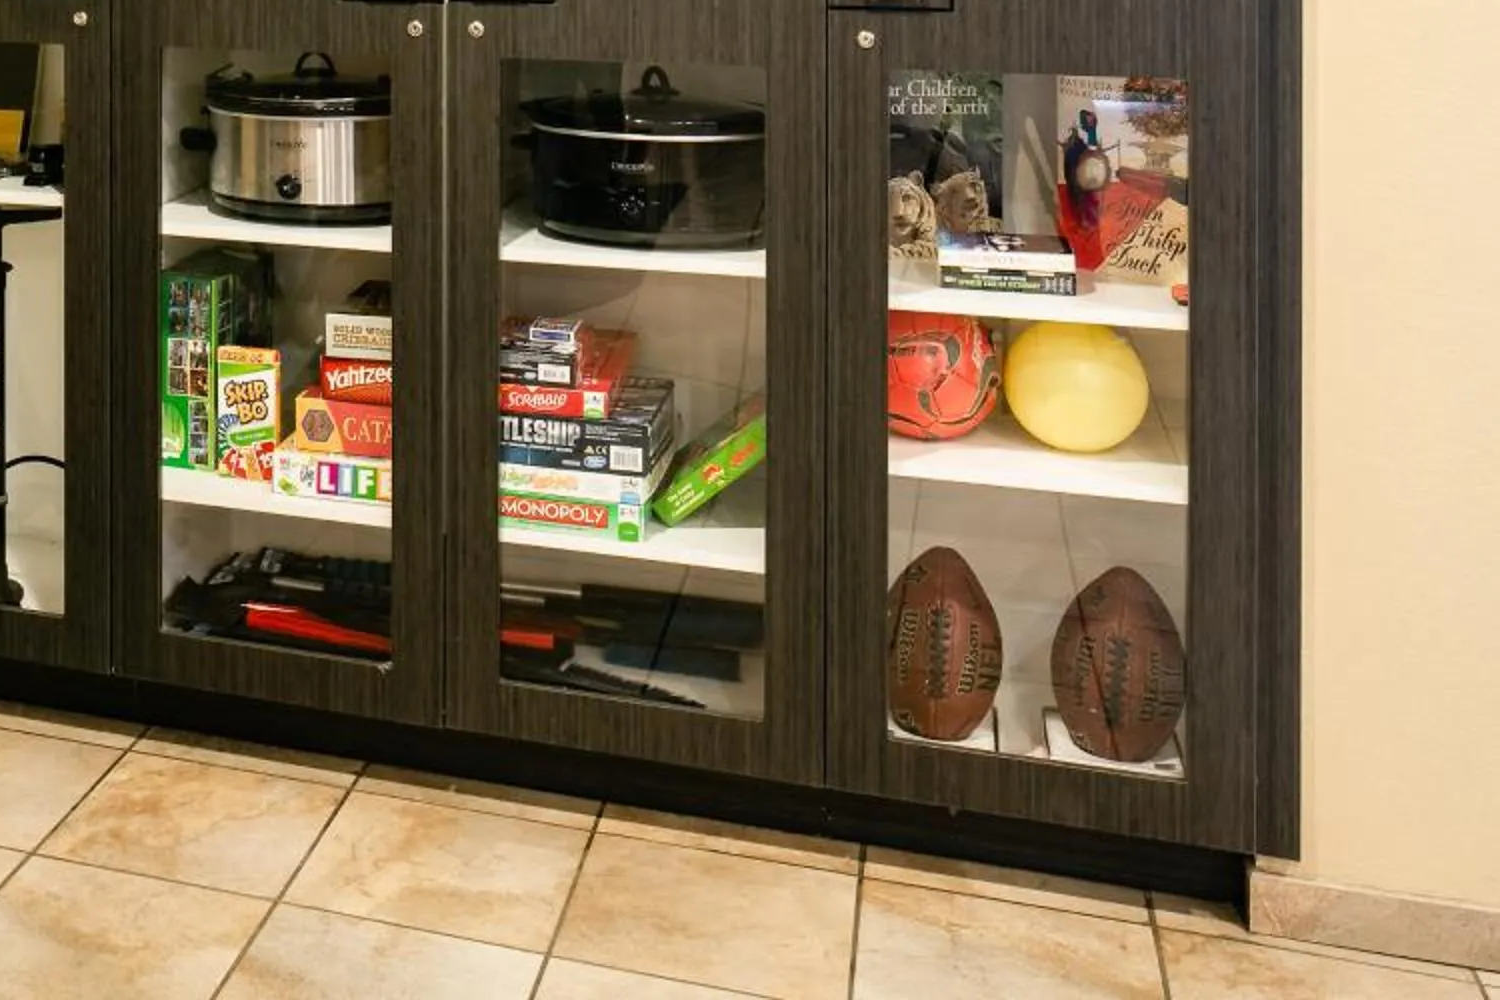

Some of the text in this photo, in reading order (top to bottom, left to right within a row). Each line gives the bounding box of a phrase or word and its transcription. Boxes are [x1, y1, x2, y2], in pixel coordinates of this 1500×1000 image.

[908, 79, 977, 97] Children
[891, 96, 988, 117] of the Earth
[1122, 222, 1187, 262] Philip
[501, 499, 605, 524] MONOPOLY
[957, 622, 980, 695] Wilson
